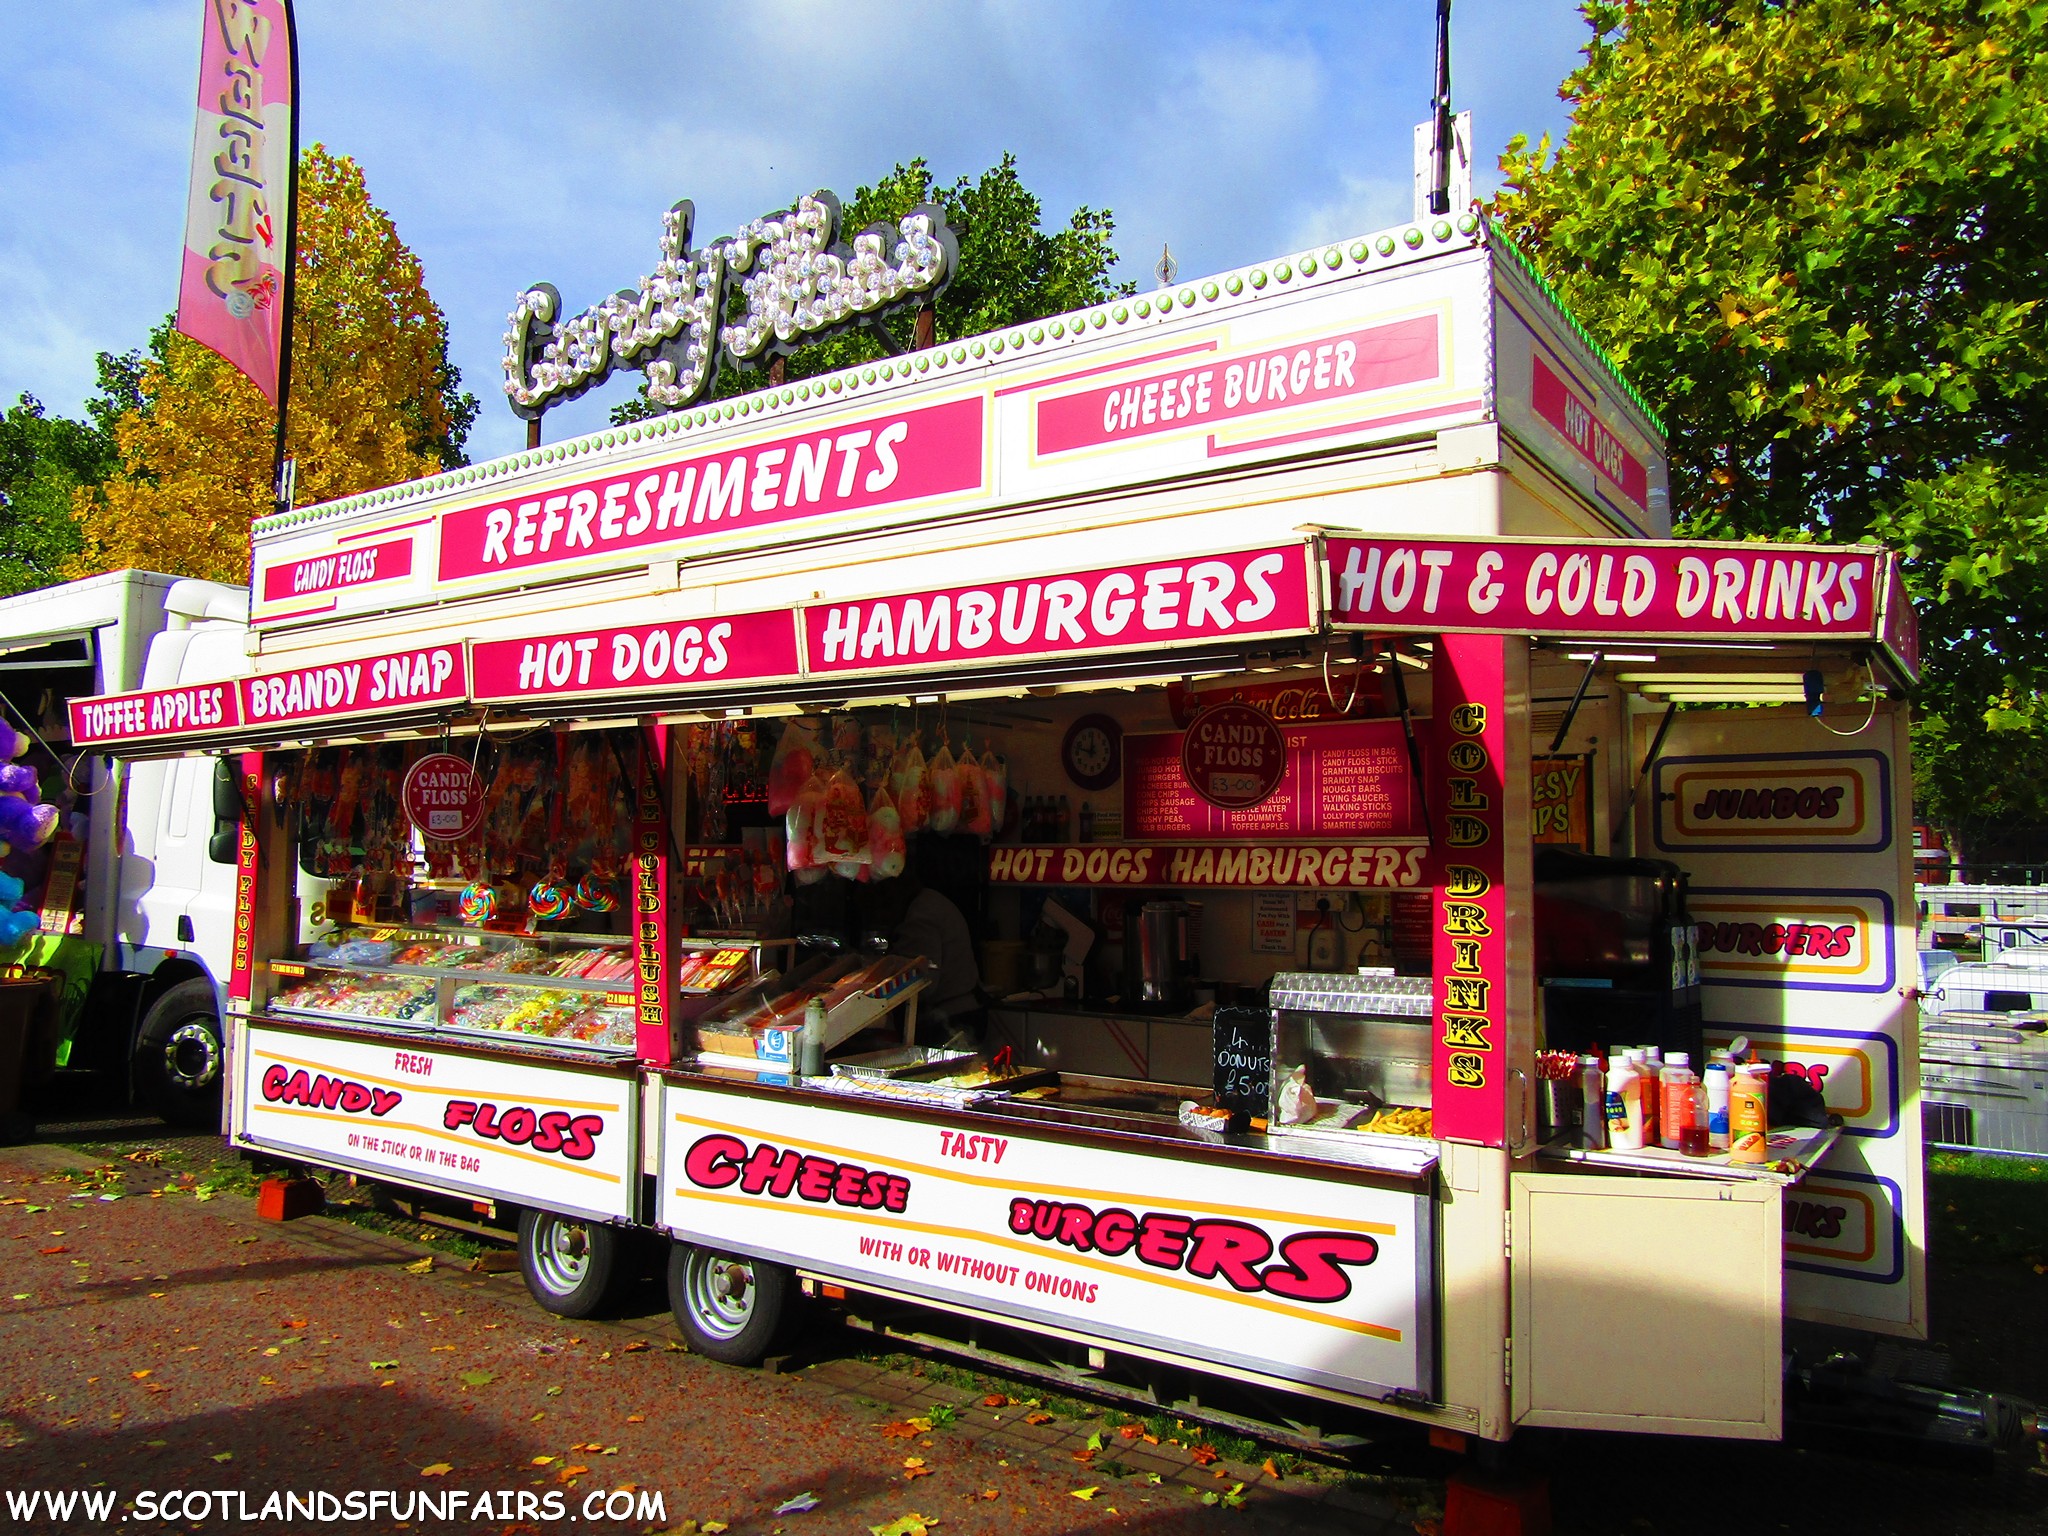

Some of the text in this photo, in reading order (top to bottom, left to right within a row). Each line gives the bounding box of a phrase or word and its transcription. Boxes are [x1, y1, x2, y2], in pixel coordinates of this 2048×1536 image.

[1103, 339, 1358, 433] CHEESE BURGER
[1565, 392, 1625, 486] HOT DOGS
[482, 420, 908, 564] REFRESHMENTS
[294, 548, 378, 593] CANDY FLOSS
[1340, 546, 1863, 625] HOT & COLD DRINKS
[822, 553, 1284, 663] HAMBURGERS
[519, 623, 733, 690] HOT DOGS
[251, 649, 453, 718] BRANDY SNAP
[82, 688, 223, 738] TOFFEE APPLES
[1199, 723, 1268, 746] CANDY
[1203, 746, 1264, 768] FLOSS
[1322, 747, 1396, 759] CANDY FLOSS IN BAG
[1322, 759, 1346, 768] CANDY
[1347, 758, 1370, 767] FLOSS
[1376, 756, 1398, 766] STICK
[418, 771, 471, 789] CANDY
[1148, 773, 1181, 782] BURGERS
[1322, 765, 1403, 777] GRANTHAM BISCUITS
[1322, 776, 1380, 786] BRANDY SNAP
[1446, 702, 1489, 848] COLD
[1148, 782, 1173, 790] CHEESE
[1157, 790, 1180, 799] CHIPS
[1322, 785, 1381, 795] NOUGAT BARS
[1533, 767, 1580, 802] ESY
[421, 789, 469, 806] FLOSS
[1136, 798, 1196, 808] CHIPS SAUSAGE
[1261, 805, 1287, 813] WATER
[1266, 796, 1292, 804] SLUSH
[1322, 793, 1389, 803] FLYING SAUCERS
[1322, 802, 1392, 812] WALKING STICKS
[1693, 786, 1845, 820] JUMBOS
[1136, 807, 1180, 816] CHIPS PEAS
[1164, 815, 1184, 823] PEAS
[1231, 814, 1247, 822] RED
[1322, 811, 1392, 822] LOLLY POPS (FROM)
[1532, 803, 1569, 835] IPS
[1157, 823, 1191, 831] BURGERS
[1231, 822, 1290, 831] TOFFEE APPLES
[1322, 820, 1392, 830] SMARTIE SWORDS
[638, 831, 661, 914] COLD
[990, 846, 1428, 887] HOT DOGS HAMBURGERS
[1695, 921, 1856, 960] BURGERS
[640, 921, 665, 1026] SLUSH
[1442, 864, 1492, 1089] DRINKS
[1231, 1026, 1249, 1050] 4
[395, 1052, 433, 1076] FRESH
[262, 1064, 604, 1161] CANDY FLOSS
[347, 1133, 481, 1173] ON THE STICK OR IN THE BAG
[939, 1130, 1009, 1165] TASTY
[684, 1133, 1379, 1303] CHEESE BURGERS
[859, 1235, 1100, 1304] WITH OR WITHOUT ONIONS
